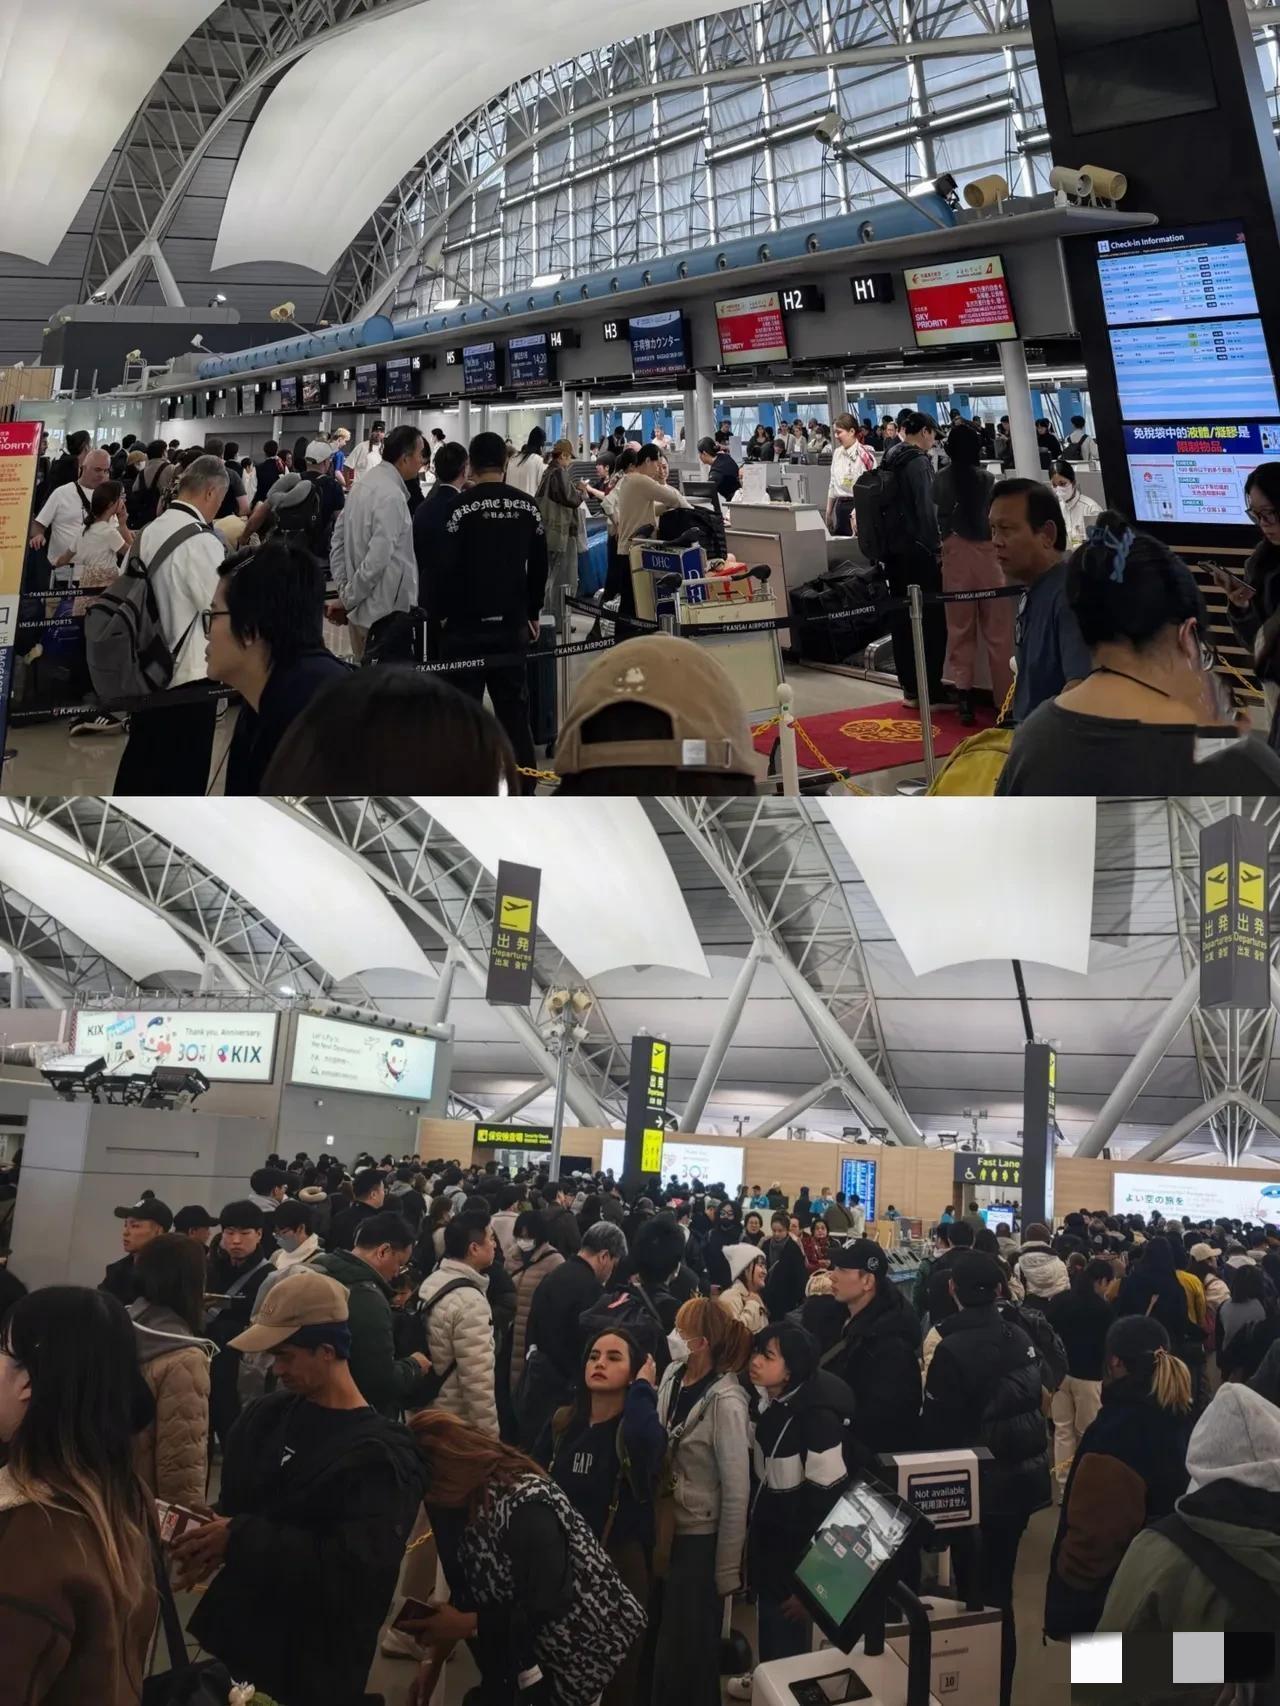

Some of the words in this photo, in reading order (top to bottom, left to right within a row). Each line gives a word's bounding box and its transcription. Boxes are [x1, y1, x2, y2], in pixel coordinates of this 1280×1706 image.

[1111, 239, 1141, 250] Check-in
[1141, 235, 1184, 246] Information
[854, 278, 875, 300] H1
[783, 289, 803, 310] H2
[915, 313, 929, 322] SKY
[916, 318, 948, 329] PRIORITY
[604, 322, 617, 339] H3
[551, 332, 562, 347] H4
[446, 351, 455, 364] H5
[652, 555, 671, 569] DHC
[851, 605, 875, 616] AIRPORTS
[39, 619, 72, 627] AIRPORTS
[726, 623, 747, 632] KANSAI
[748, 621, 776, 630] AIRPORTS
[558, 644, 583, 655] KANSAI
[584, 638, 615, 650] AIRPORTS
[421, 661, 449, 673] KANSAI
[449, 658, 485, 670] AIRPORTS
[1238, 912, 1265, 937] 出発
[497, 933, 529, 952] 出発
[1203, 936, 1232, 951] Departures
[1233, 931, 1267, 950] Departures
[492, 947, 532, 961] Departures
[87, 1025, 104, 1036] KIX
[185, 1028, 204, 1036] Thank
[231, 1045, 262, 1063] KIX
[977, 1157, 996, 1167] Fast
[998, 1158, 1021, 1168] Lane
[1126, 1193, 1184, 1206] よい空の旅を
[572, 1452, 593, 1474] GAP
[915, 1489, 930, 1499] Not
[931, 1486, 966, 1497] available
[945, 1676, 955, 1688] 10
